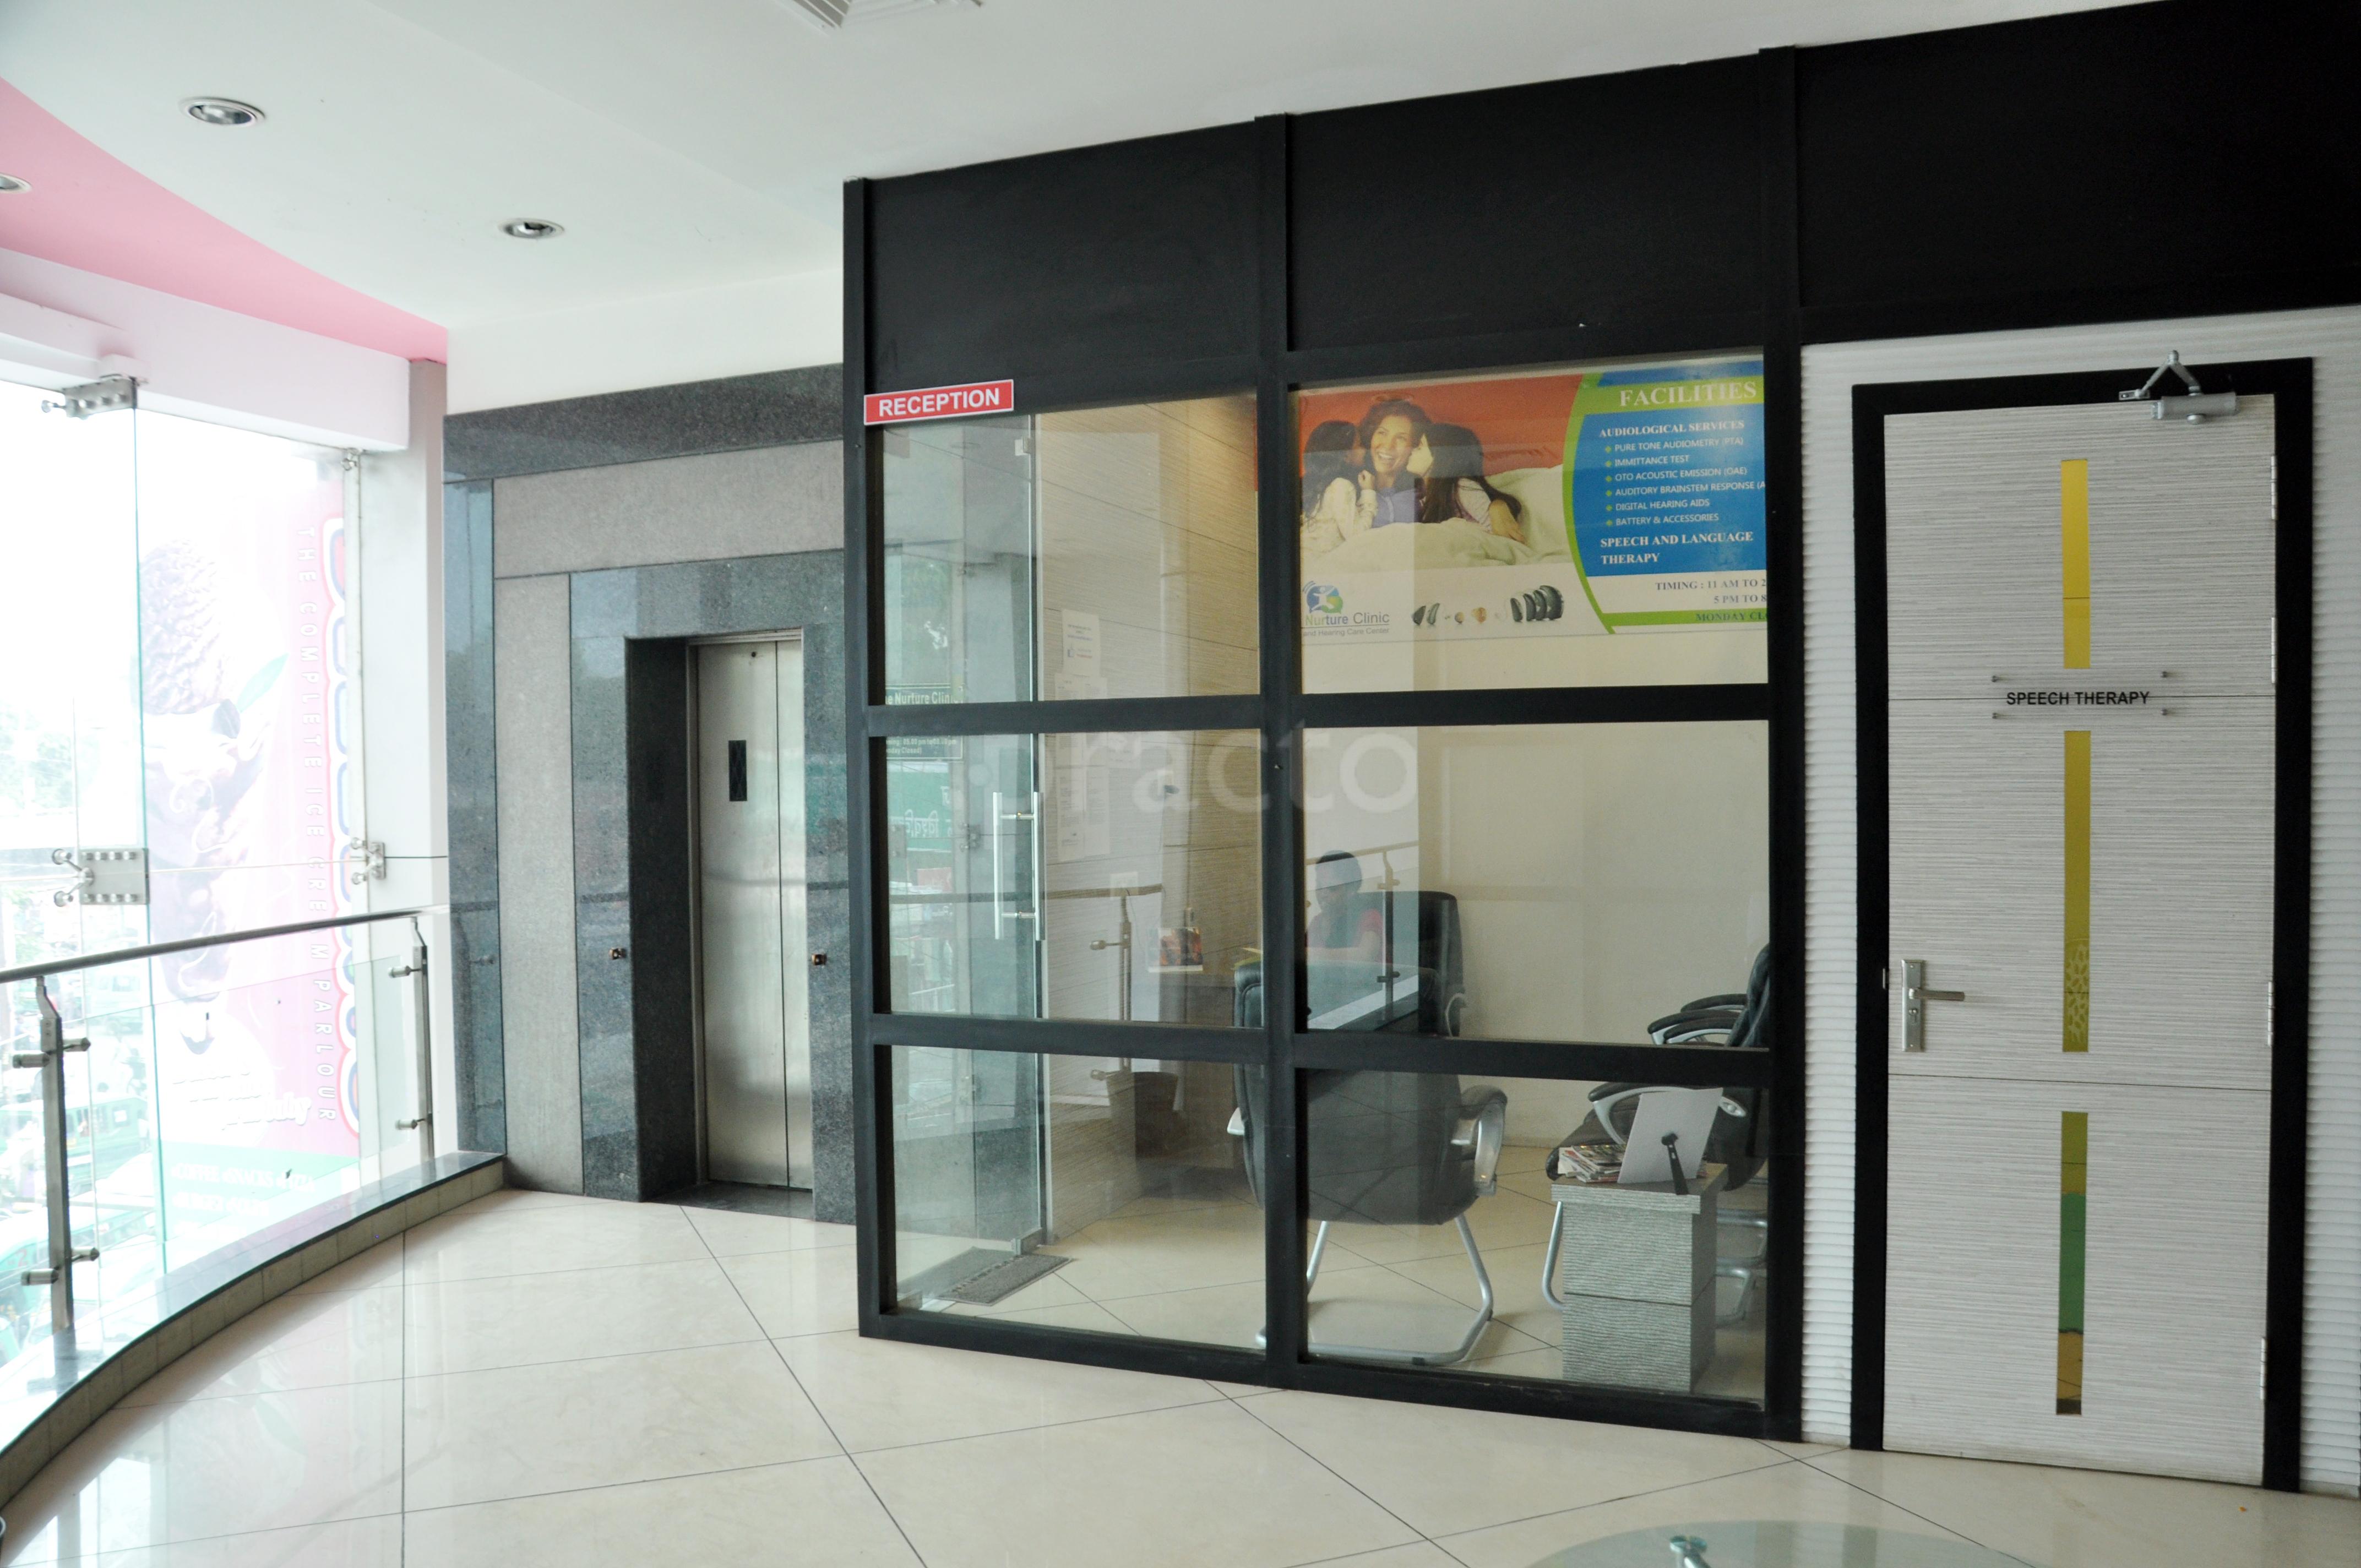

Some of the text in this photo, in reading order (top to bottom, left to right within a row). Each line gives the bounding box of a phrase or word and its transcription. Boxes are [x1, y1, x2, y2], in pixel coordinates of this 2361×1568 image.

[1620, 381, 1756, 407] FACILITIES
[879, 388, 999, 417] RECEPTION
[1600, 420, 1745, 438] AUDIOLOGICAL SERVICES
[1614, 437, 1744, 451] PURE TONE AUDIOMETRY (PTA)
[1615, 455, 1690, 466] IMMITTANCE TEST
[1636, 470, 1678, 480] ACOUSTIC
[1680, 468, 1721, 478] EMISSION
[1724, 467, 1748, 477] (OAE)
[1615, 487, 1658, 496] AUDITORY
[1660, 483, 1708, 493] BRAINSTEM
[1711, 481, 1754, 491] RESPONSE
[1616, 498, 1710, 511] DIGITAL HEARING AIDS
[1616, 513, 1719, 526] BATTERY & ACCESSORIES
[1601, 531, 1753, 548] SPEECH AND LANGUAGE
[1601, 553, 1660, 564] THERAPY
[1655, 581, 1698, 591] TIMING
[1721, 580, 1739, 588] AM
[1742, 579, 1758, 587] TO
[1722, 595, 1739, 603] PM
[1742, 594, 1758, 602] TO
[1305, 612, 1390, 626] Nurture Clinic
[1695, 612, 1745, 622] MONDAY
[895, 692, 929, 705] Nurture
[2006, 691, 2150, 705] SPEECH THERAPY
[297, 527, 336, 1120] THE COMPLETE ICE CREM PARLOUR
